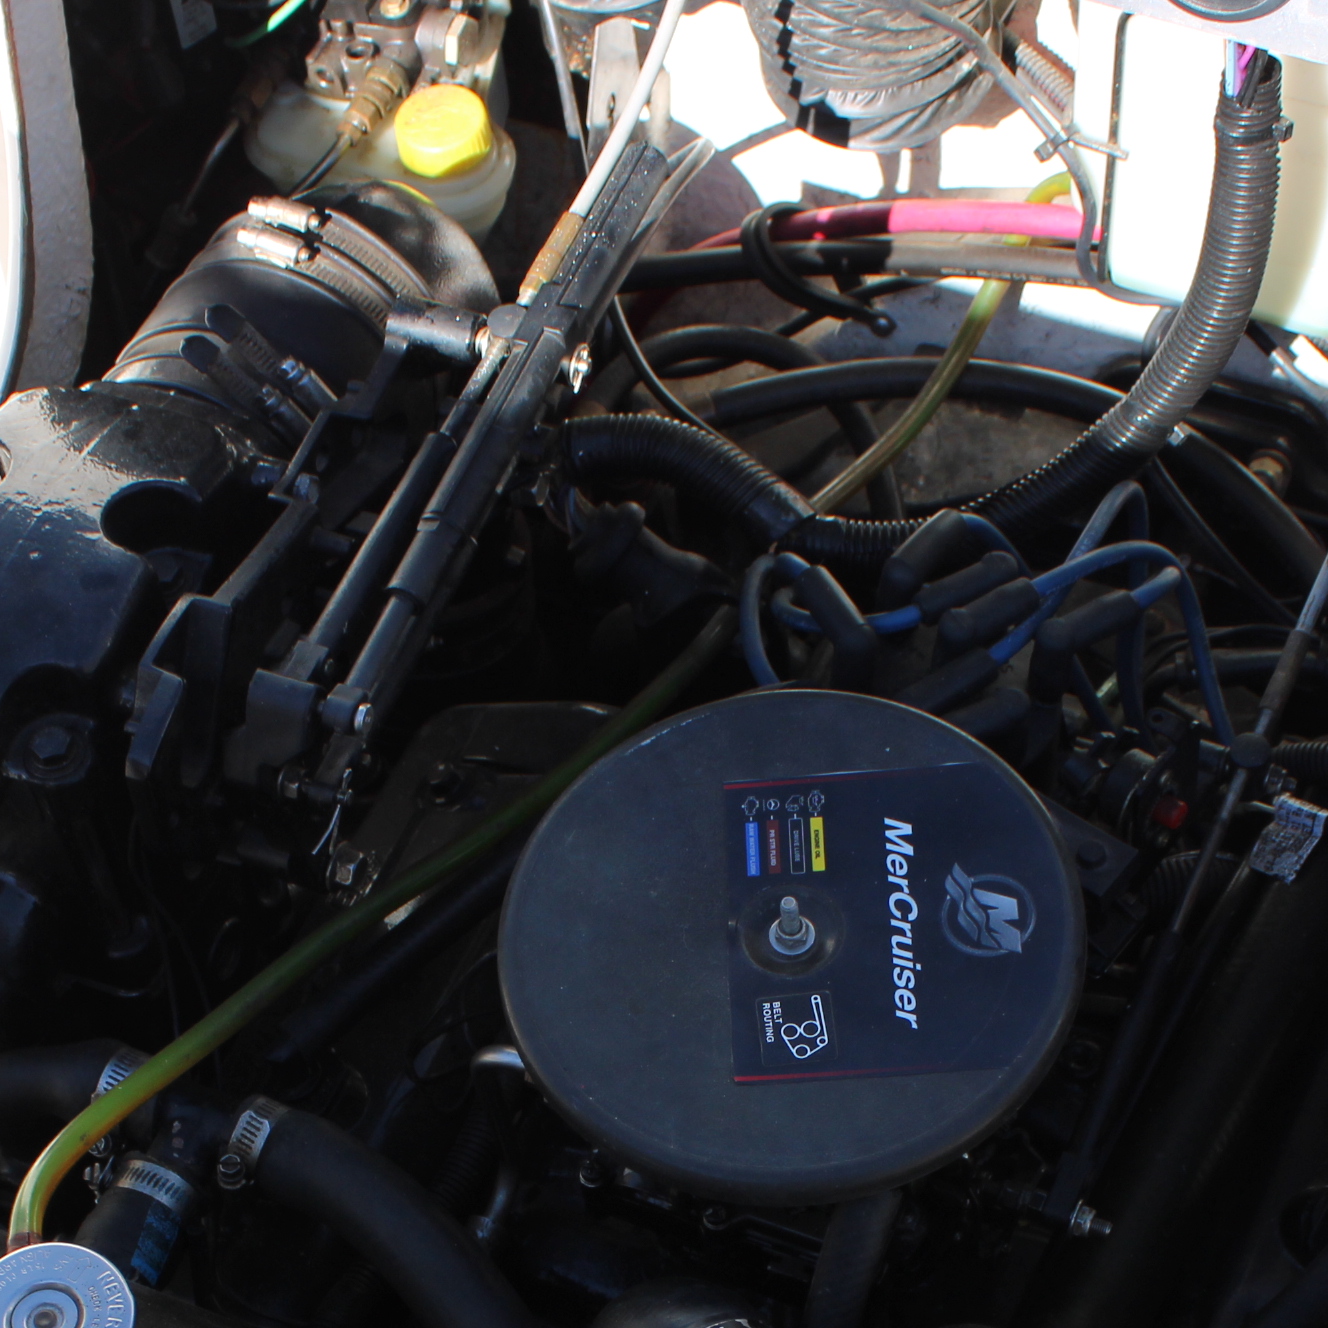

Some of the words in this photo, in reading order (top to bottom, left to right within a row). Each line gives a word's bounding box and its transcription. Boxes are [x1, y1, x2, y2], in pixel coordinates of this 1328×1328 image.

[769, 829, 776, 838] PR
[793, 829, 801, 846] DRIVE
[770, 850, 778, 867] FLUID
[882, 817, 920, 1030] MerCruiser
[762, 1002, 775, 1043] ROUTING
[772, 1001, 783, 1024] BELT
[87, 1286, 102, 1312] CHECK
[97, 1270, 125, 1328] NEVER
